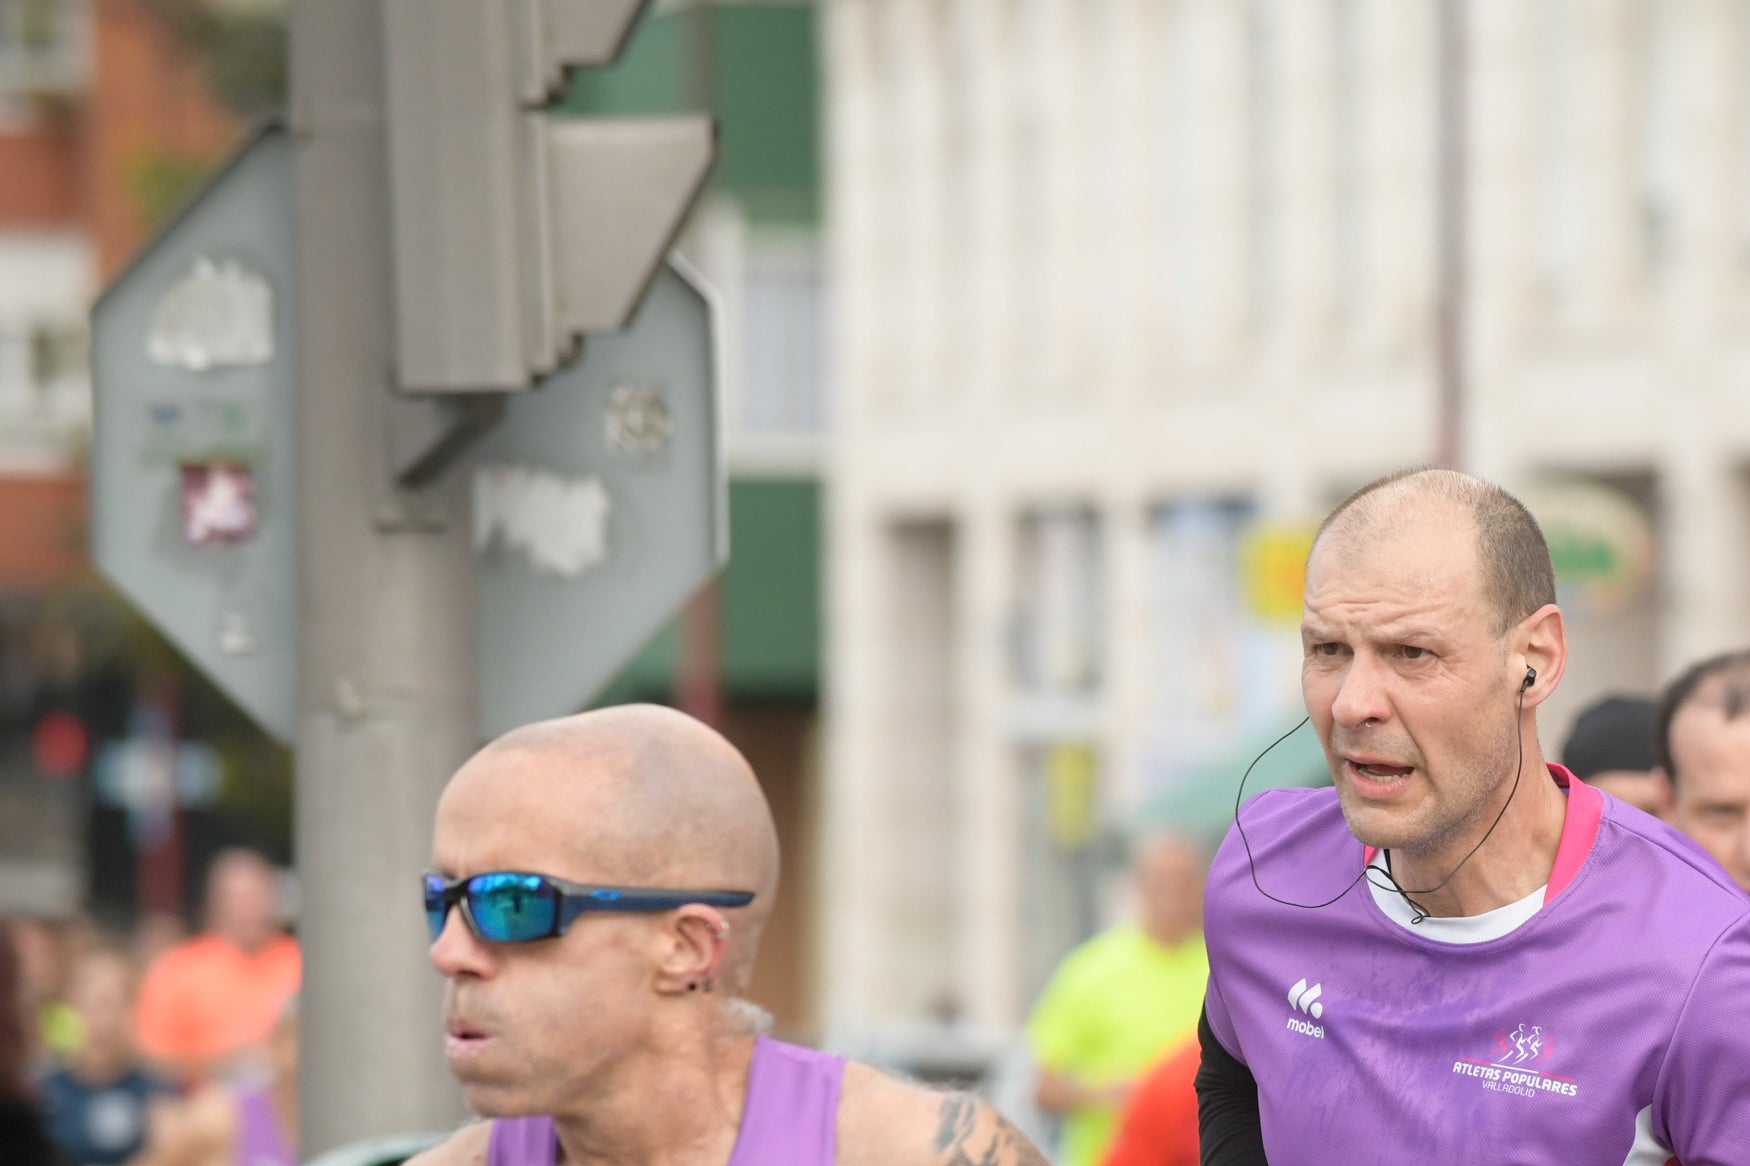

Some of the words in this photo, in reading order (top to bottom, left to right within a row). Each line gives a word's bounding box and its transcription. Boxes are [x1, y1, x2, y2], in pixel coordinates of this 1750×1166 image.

[1286, 1017, 1325, 1040] mobel
[1453, 1061, 1502, 1082] ATLETAS
[1502, 1070, 1578, 1096] POPULARES
[1482, 1079, 1535, 1099] VALLADOLID
